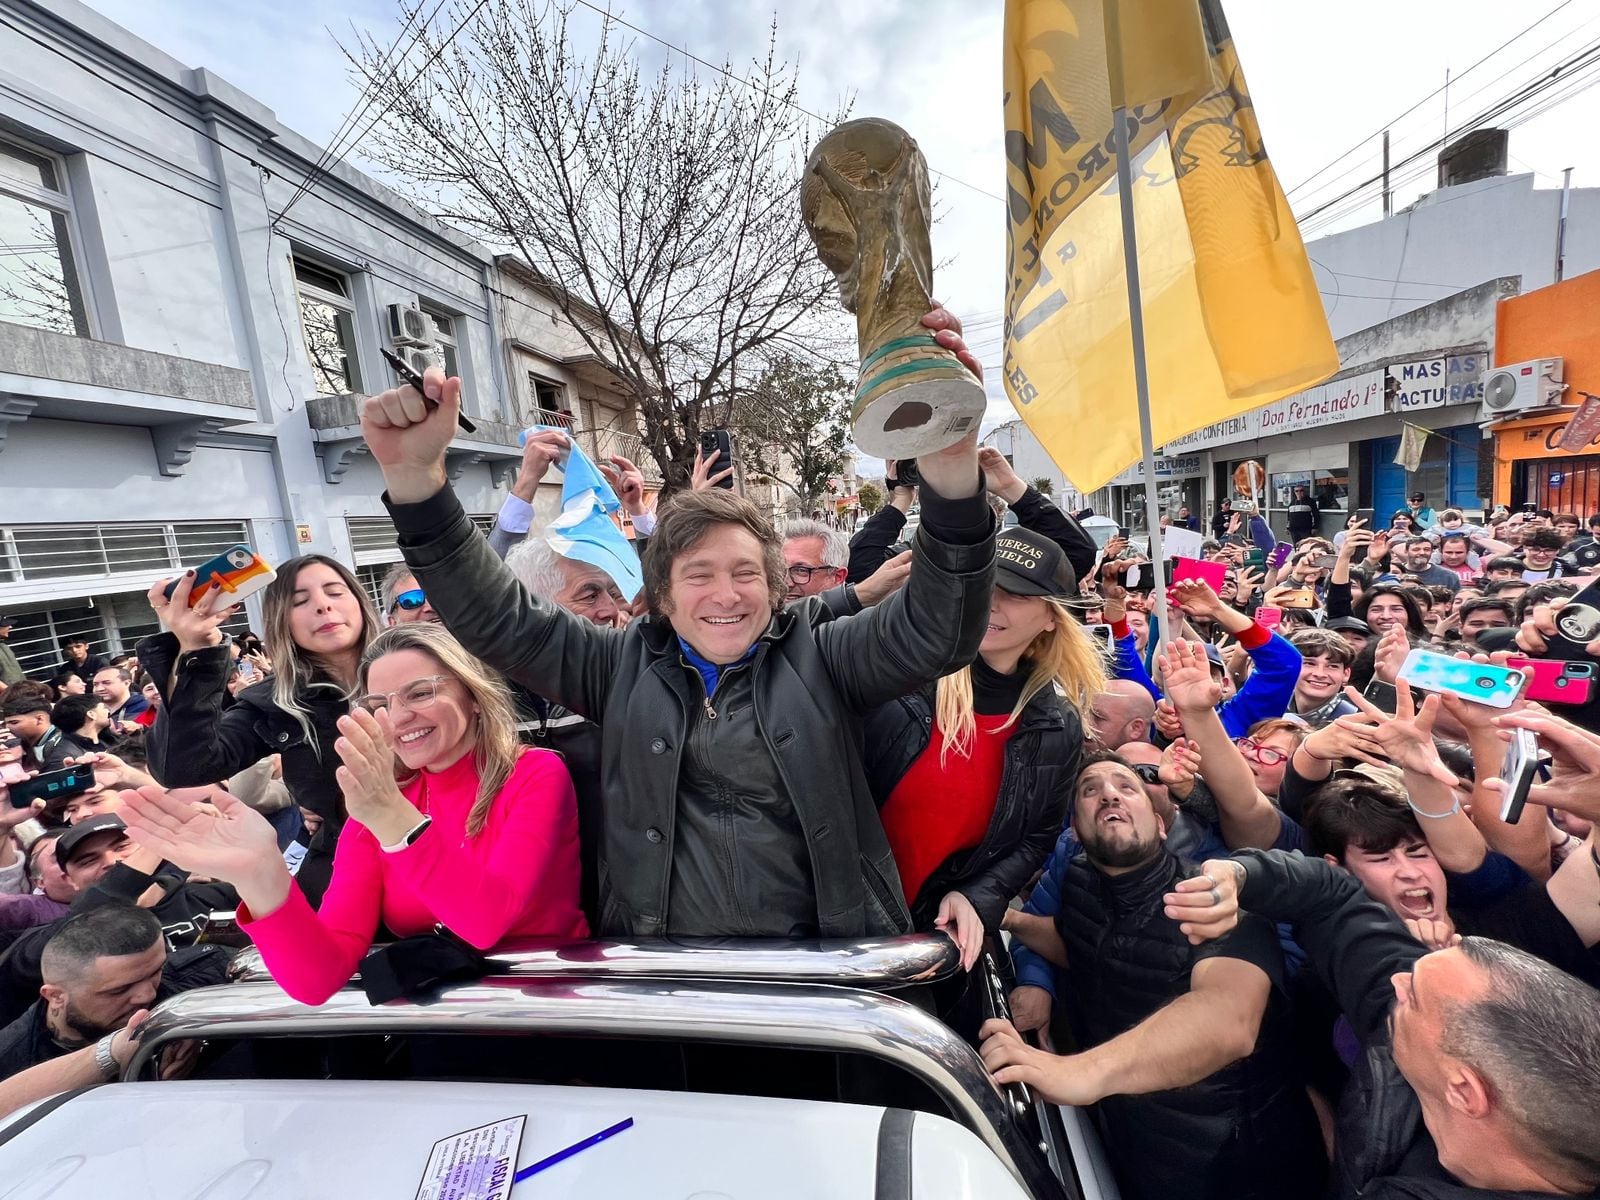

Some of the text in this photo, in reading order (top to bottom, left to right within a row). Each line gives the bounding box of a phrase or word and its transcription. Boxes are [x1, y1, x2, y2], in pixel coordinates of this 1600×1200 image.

[1262, 409, 1284, 428] Don
[1288, 389, 1360, 422] Fernando
[1203, 415, 1247, 440] CONFITERIA
[1184, 466, 1200, 474] SUR
[488, 1156, 510, 1194] FISCAL
